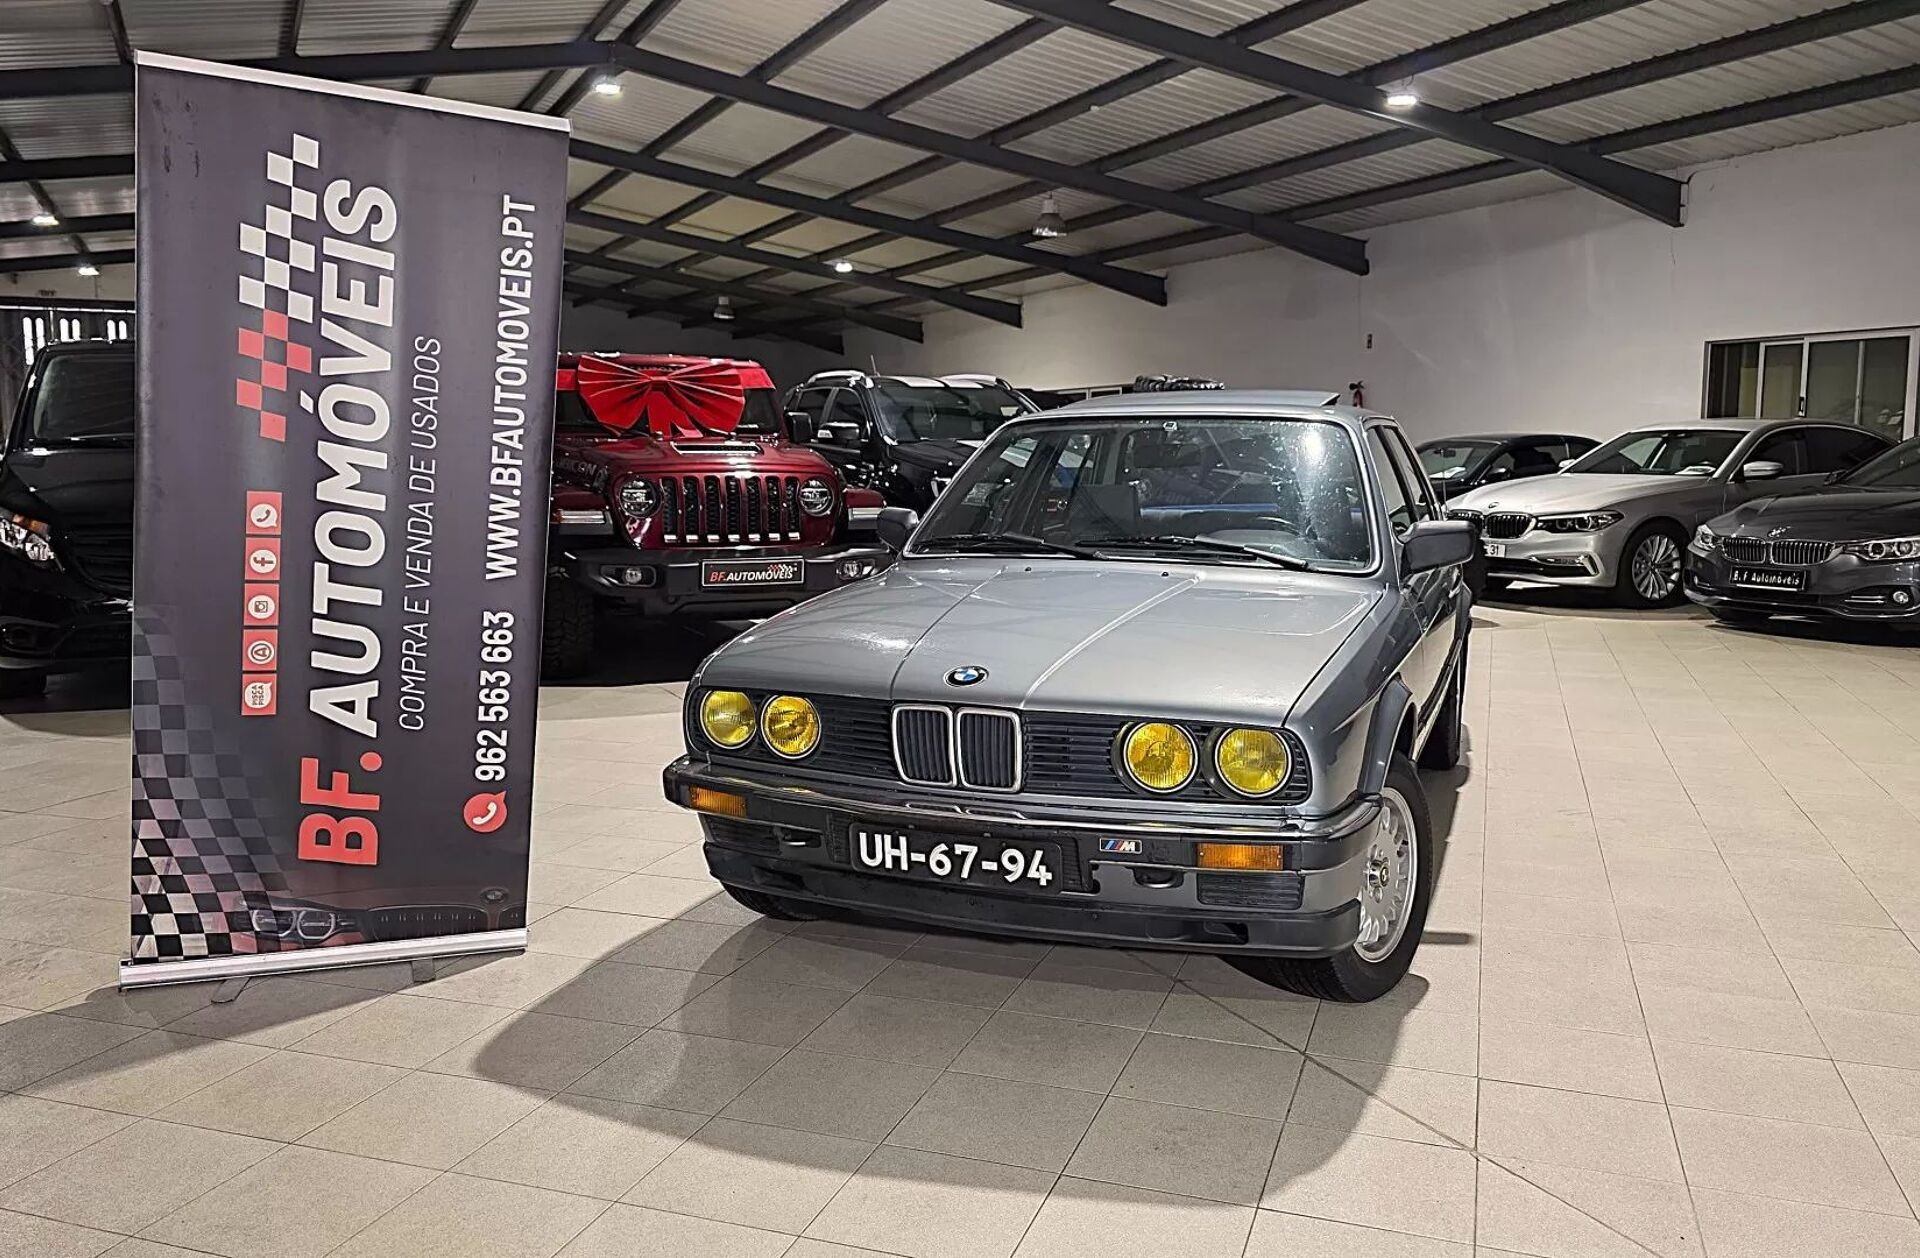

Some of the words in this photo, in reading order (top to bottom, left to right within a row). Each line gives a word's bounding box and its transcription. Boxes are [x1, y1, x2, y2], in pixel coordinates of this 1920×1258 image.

[410, 336, 441, 450] USADOS
[485, 194, 536, 580] WWW.BFAUTOMOVEIS.PT
[408, 455, 436, 494] DE
[405, 502, 434, 588] VENDA
[403, 596, 430, 615] E
[481, 611, 515, 663] 663
[399, 623, 429, 731] COMPRA
[478, 670, 511, 722] 563
[475, 729, 508, 782] 962
[859, 832, 1052, 886] UH-67-94
